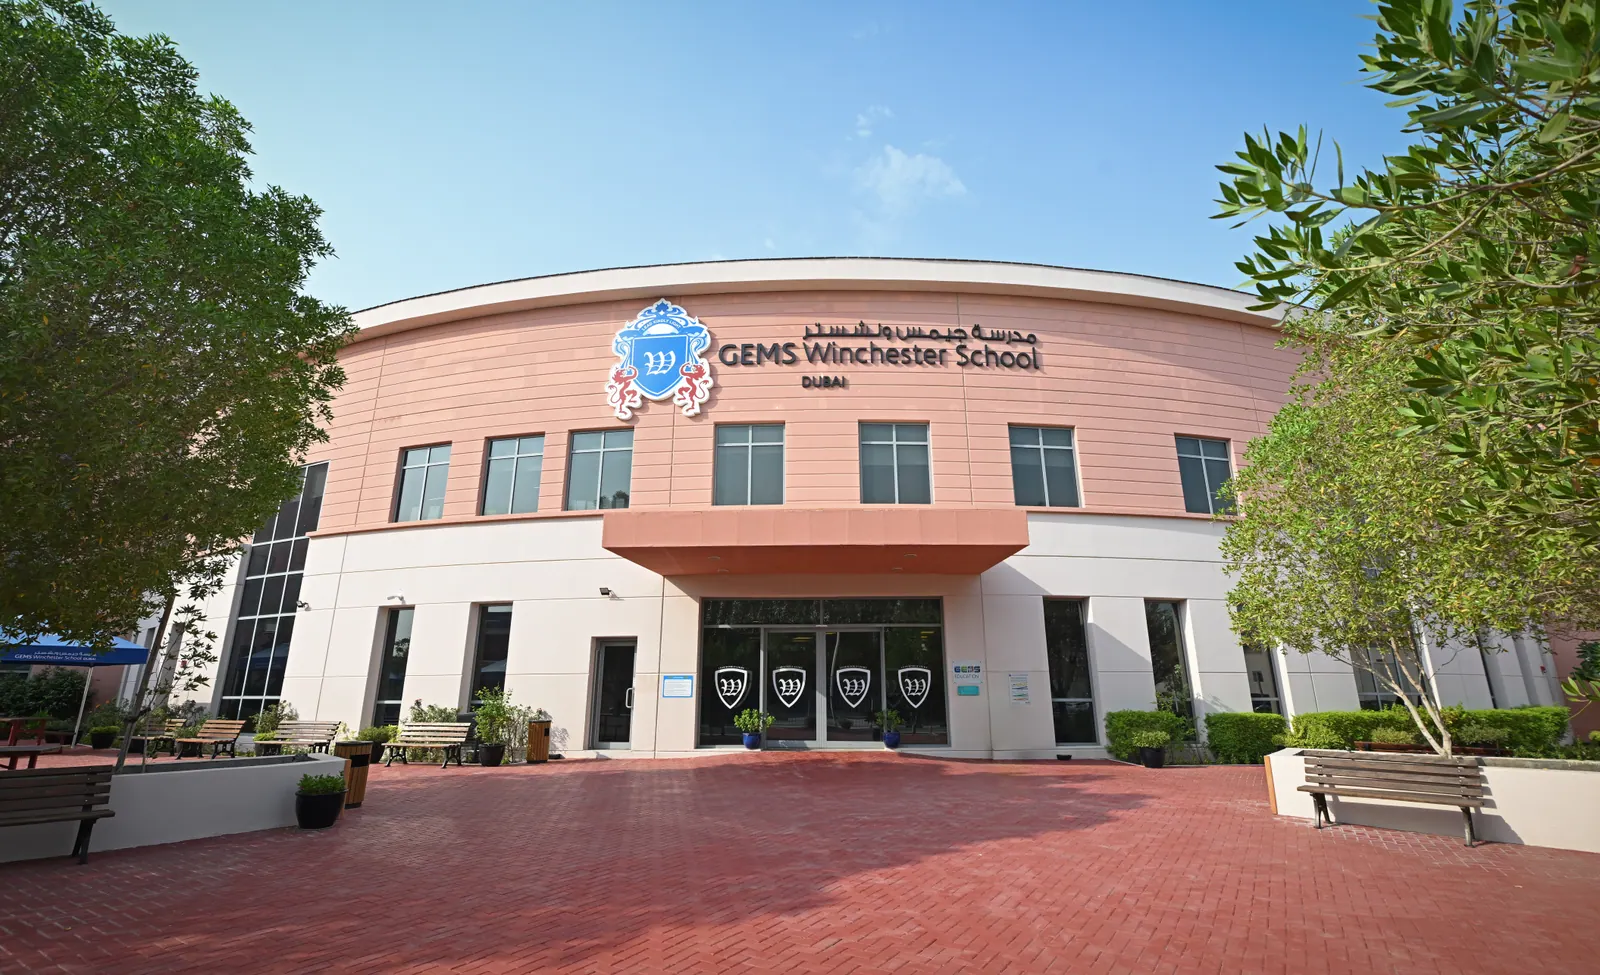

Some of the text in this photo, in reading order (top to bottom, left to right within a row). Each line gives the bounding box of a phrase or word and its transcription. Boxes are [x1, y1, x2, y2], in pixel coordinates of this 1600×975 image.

[896, 326, 968, 342] جيمس
[971, 323, 1037, 344] مدرسة
[718, 341, 1040, 369] GEMS Winchester School
[802, 375, 845, 388] DUBAI
